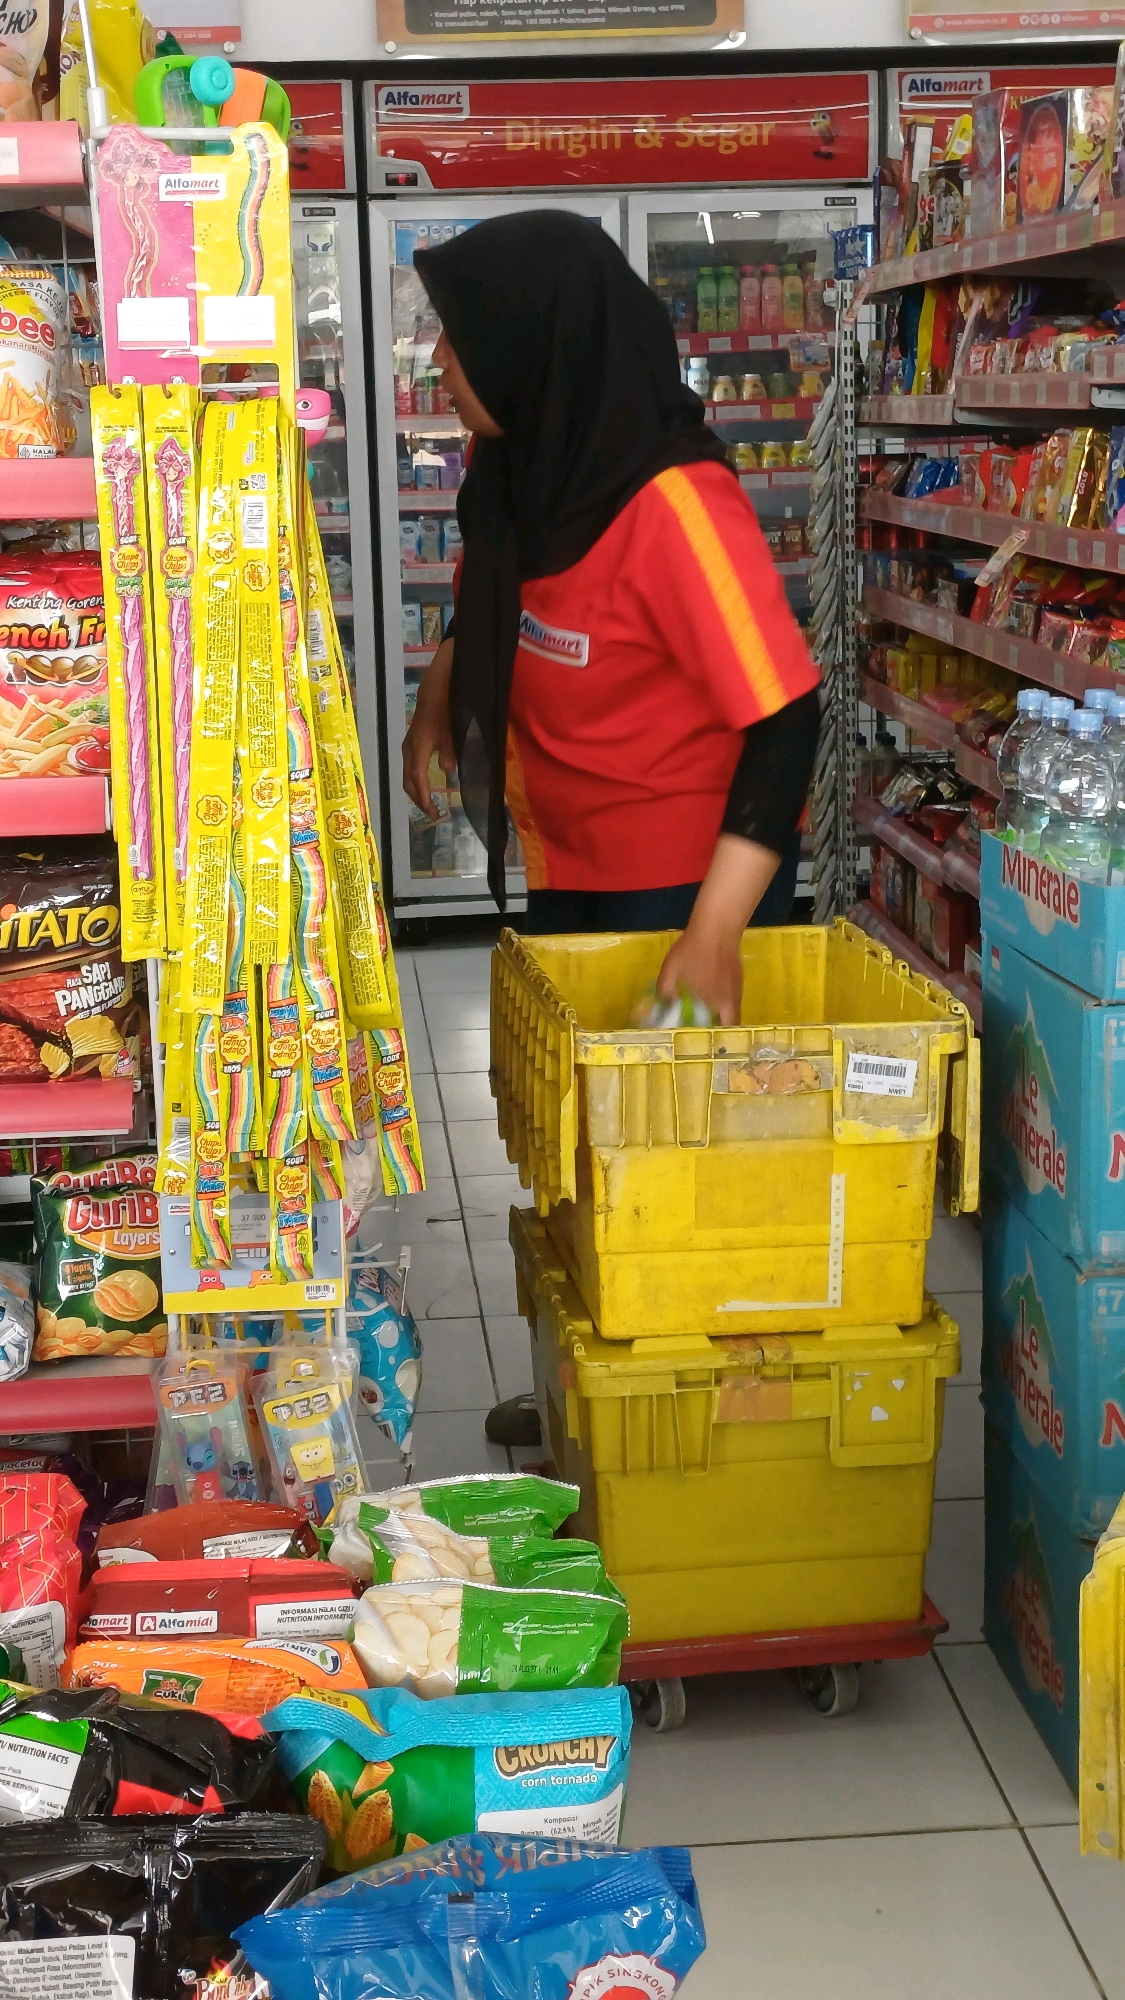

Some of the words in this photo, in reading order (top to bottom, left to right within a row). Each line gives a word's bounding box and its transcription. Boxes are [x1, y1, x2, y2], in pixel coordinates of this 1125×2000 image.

[908, 78, 984, 93] Alfamart
[384, 91, 463, 106] Alfamart
[505, 118, 622, 158] Dingin
[634, 116, 664, 149] &
[675, 116, 776, 155] Segar
[165, 178, 220, 189] Alfamart
[6, 594, 62, 609] Kentang
[1002, 844, 1080, 924] Minerale
[81, 962, 111, 985] SAPI
[54, 976, 126, 1017] PANGGANG
[1020, 1046, 1039, 1116] Le
[1020, 1298, 1039, 1371] Le
[168, 1382, 228, 1409] PEZ
[272, 1392, 330, 1420] PEZ
[276, 1615, 313, 1624] NUTRITION
[280, 1607, 318, 1616] INFORMASI
[318, 1606, 337, 1614] NILAI
[158, 1616, 214, 1629] Alfamidi
[8, 1742, 48, 1759] NUTRITION
[47, 1752, 70, 1765] FACTS
[497, 1735, 615, 1773] CRUNCHY
[12, 1781, 40, 1794] SERVING
[521, 1777, 547, 1787] corn
[550, 1771, 598, 1786] tornado
[543, 1815, 578, 1824] Komposisi
